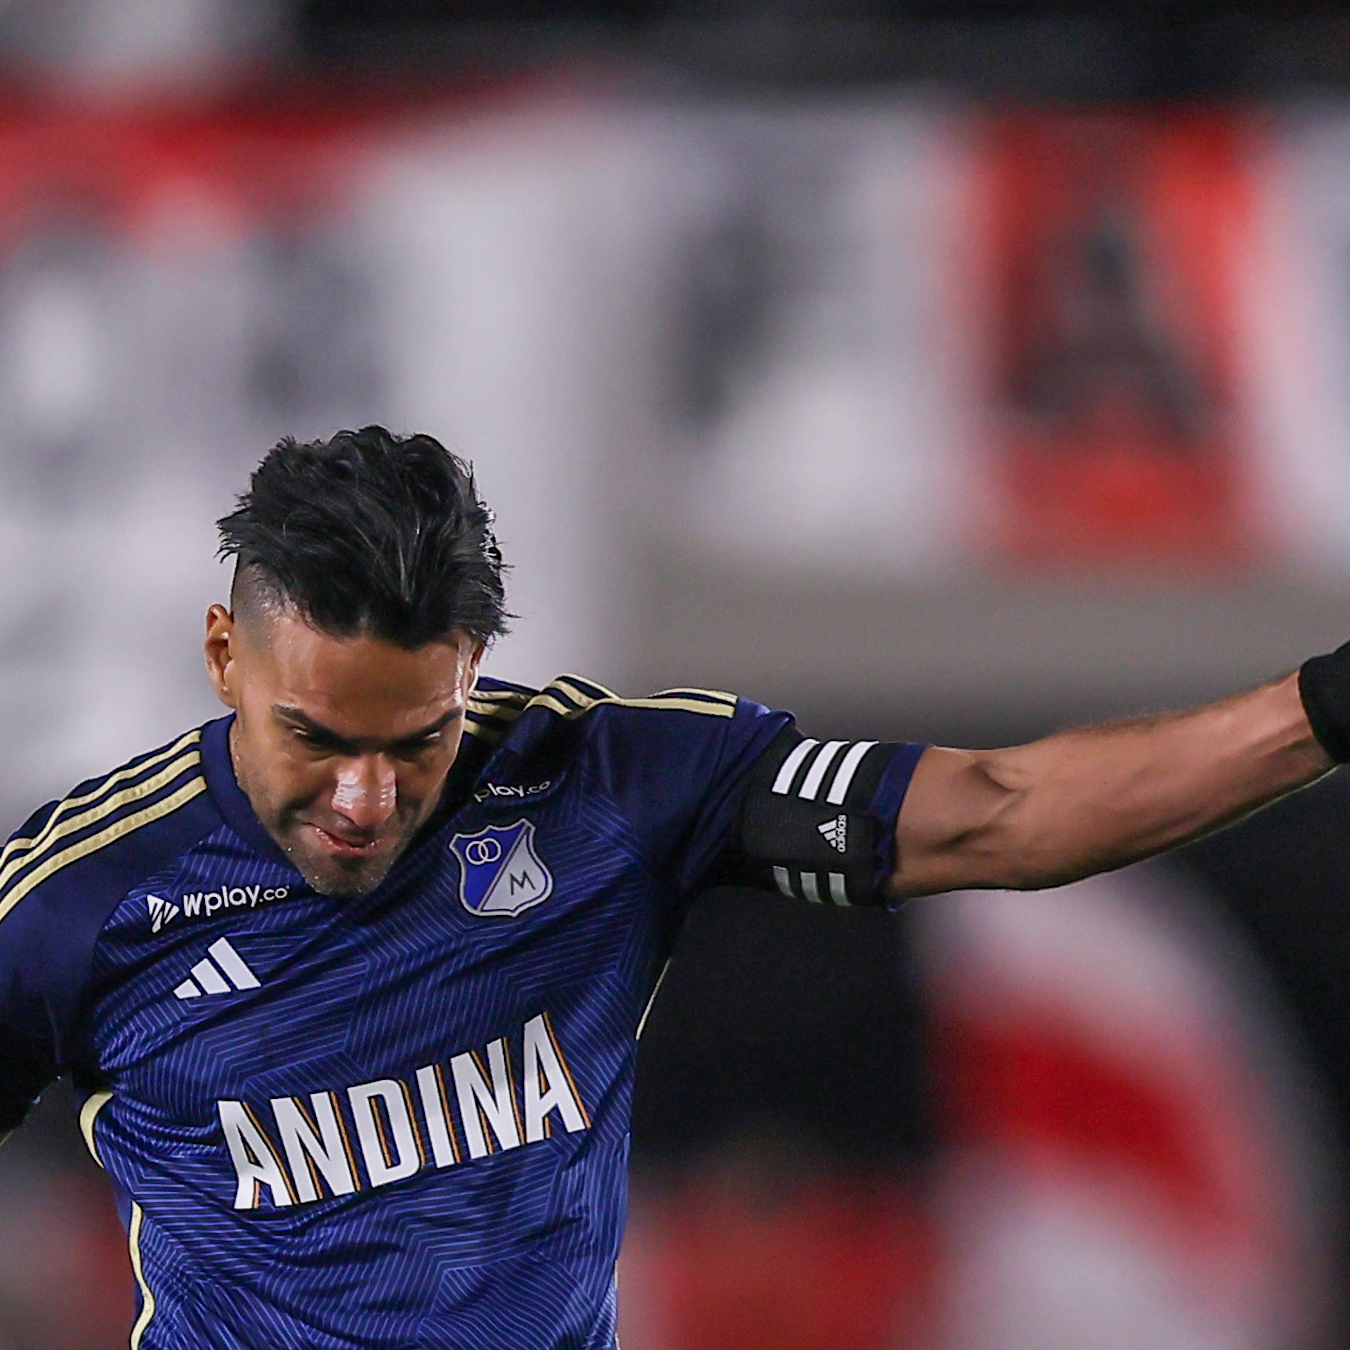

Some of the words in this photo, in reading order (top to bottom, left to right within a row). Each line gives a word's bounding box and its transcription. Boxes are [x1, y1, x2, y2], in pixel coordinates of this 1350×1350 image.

[473, 780, 551, 803] play.co
[836, 814, 847, 853] adidas
[510, 869, 537, 897] M
[182, 884, 290, 918] Wplay.co
[217, 1011, 592, 1210] ANDINA
